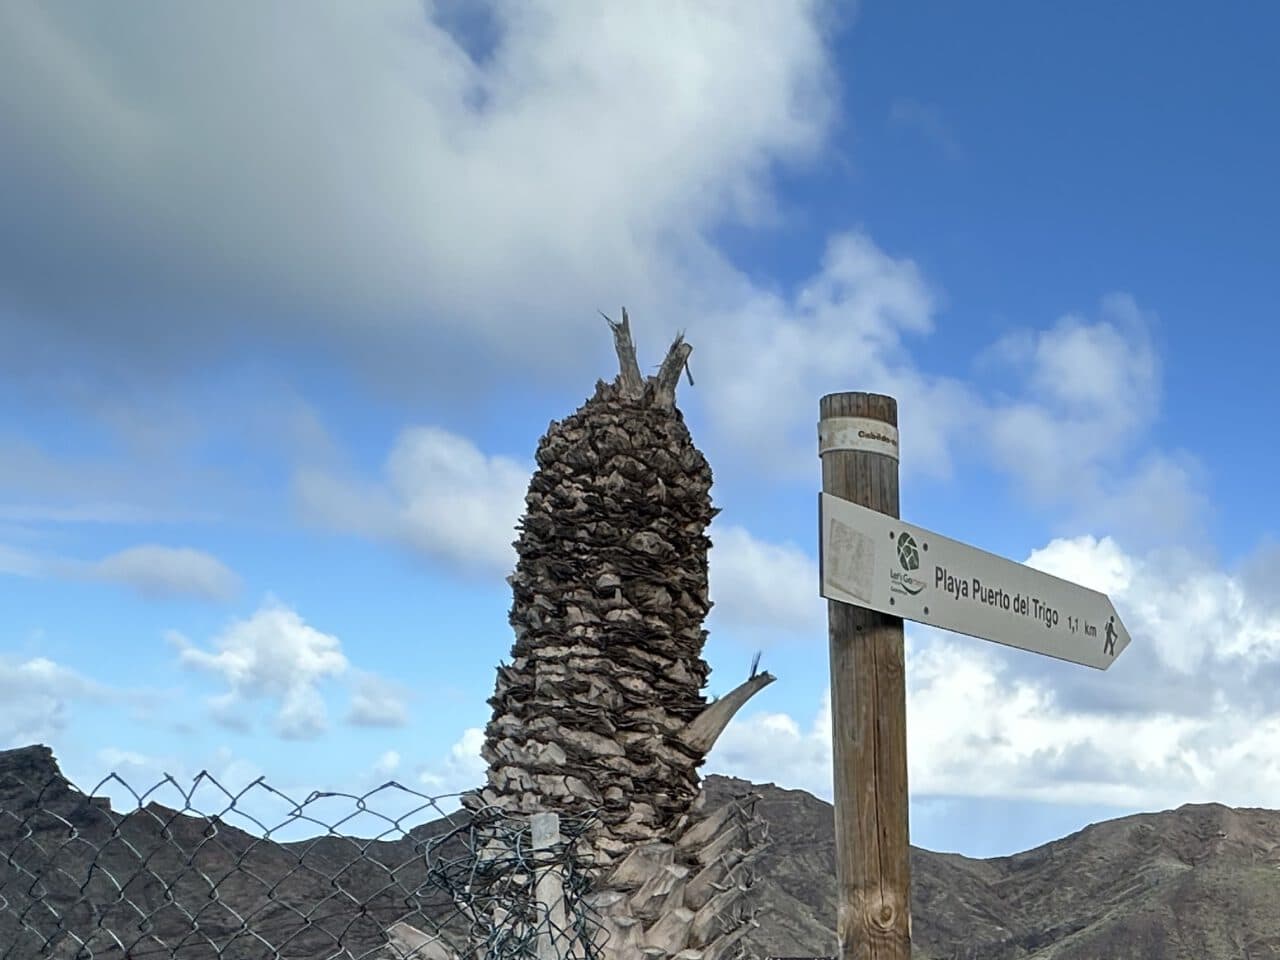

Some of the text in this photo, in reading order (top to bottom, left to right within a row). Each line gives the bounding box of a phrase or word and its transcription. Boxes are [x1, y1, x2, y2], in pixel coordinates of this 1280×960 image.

[935, 566, 1097, 637] Playa Puerto del Trigo 1,1 km
